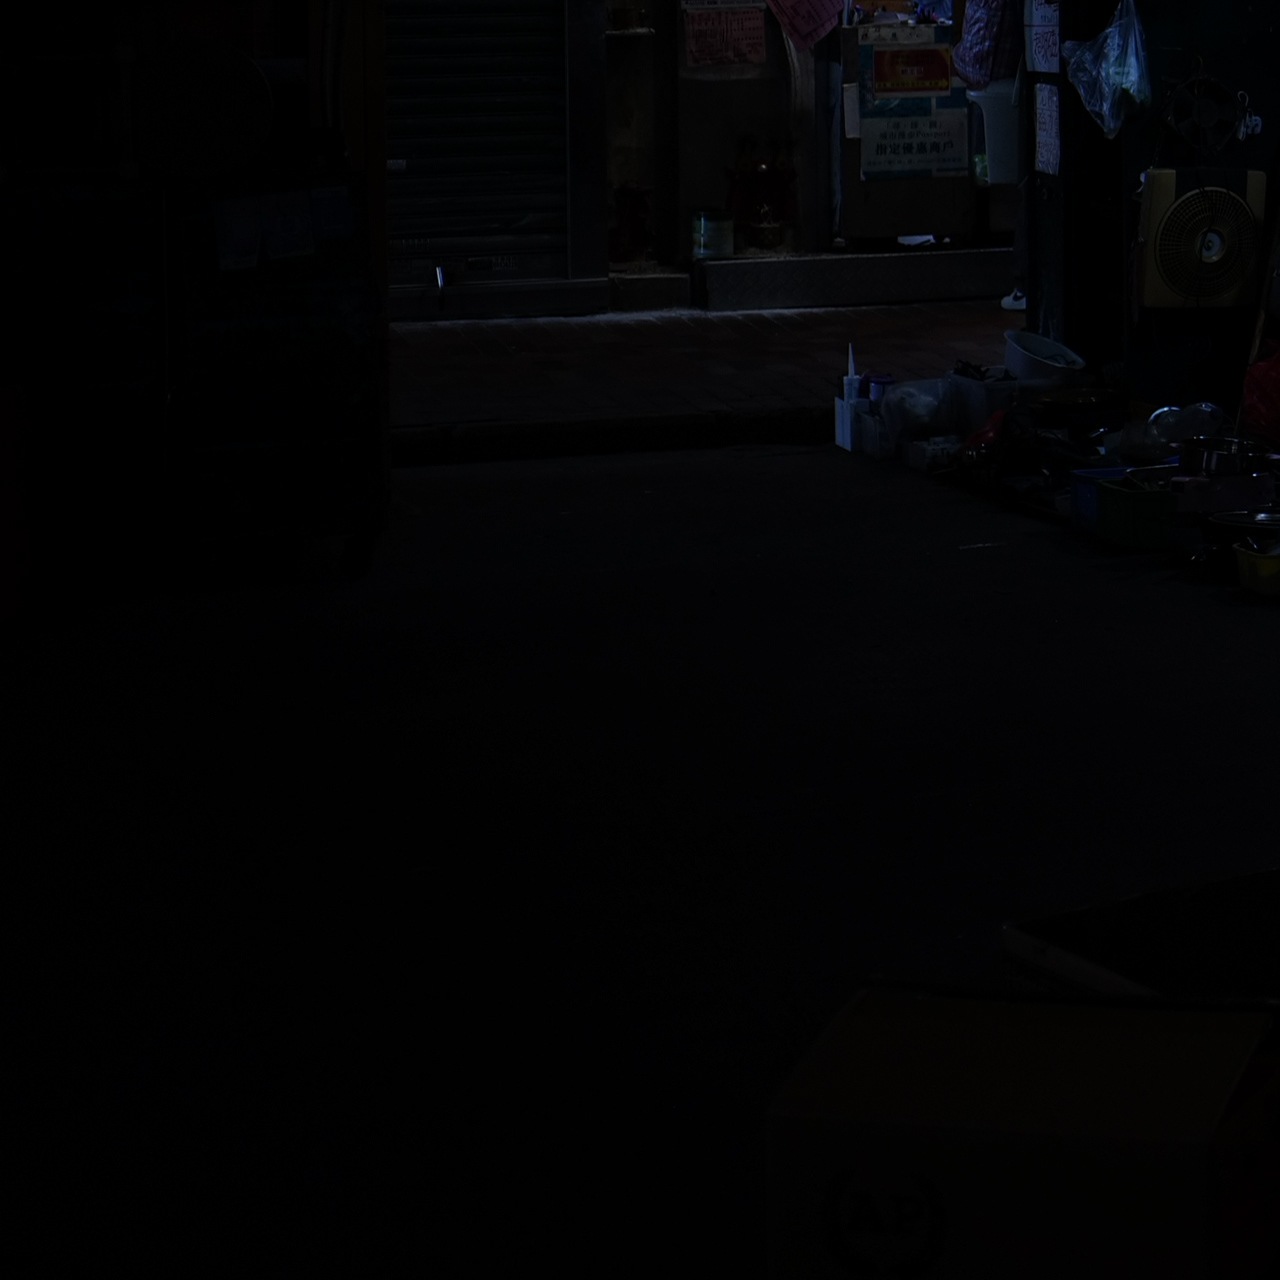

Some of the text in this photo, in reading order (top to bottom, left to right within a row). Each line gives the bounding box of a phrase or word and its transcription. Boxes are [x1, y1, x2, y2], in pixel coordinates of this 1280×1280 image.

[876, 138, 955, 158] 指定優惠商戶
